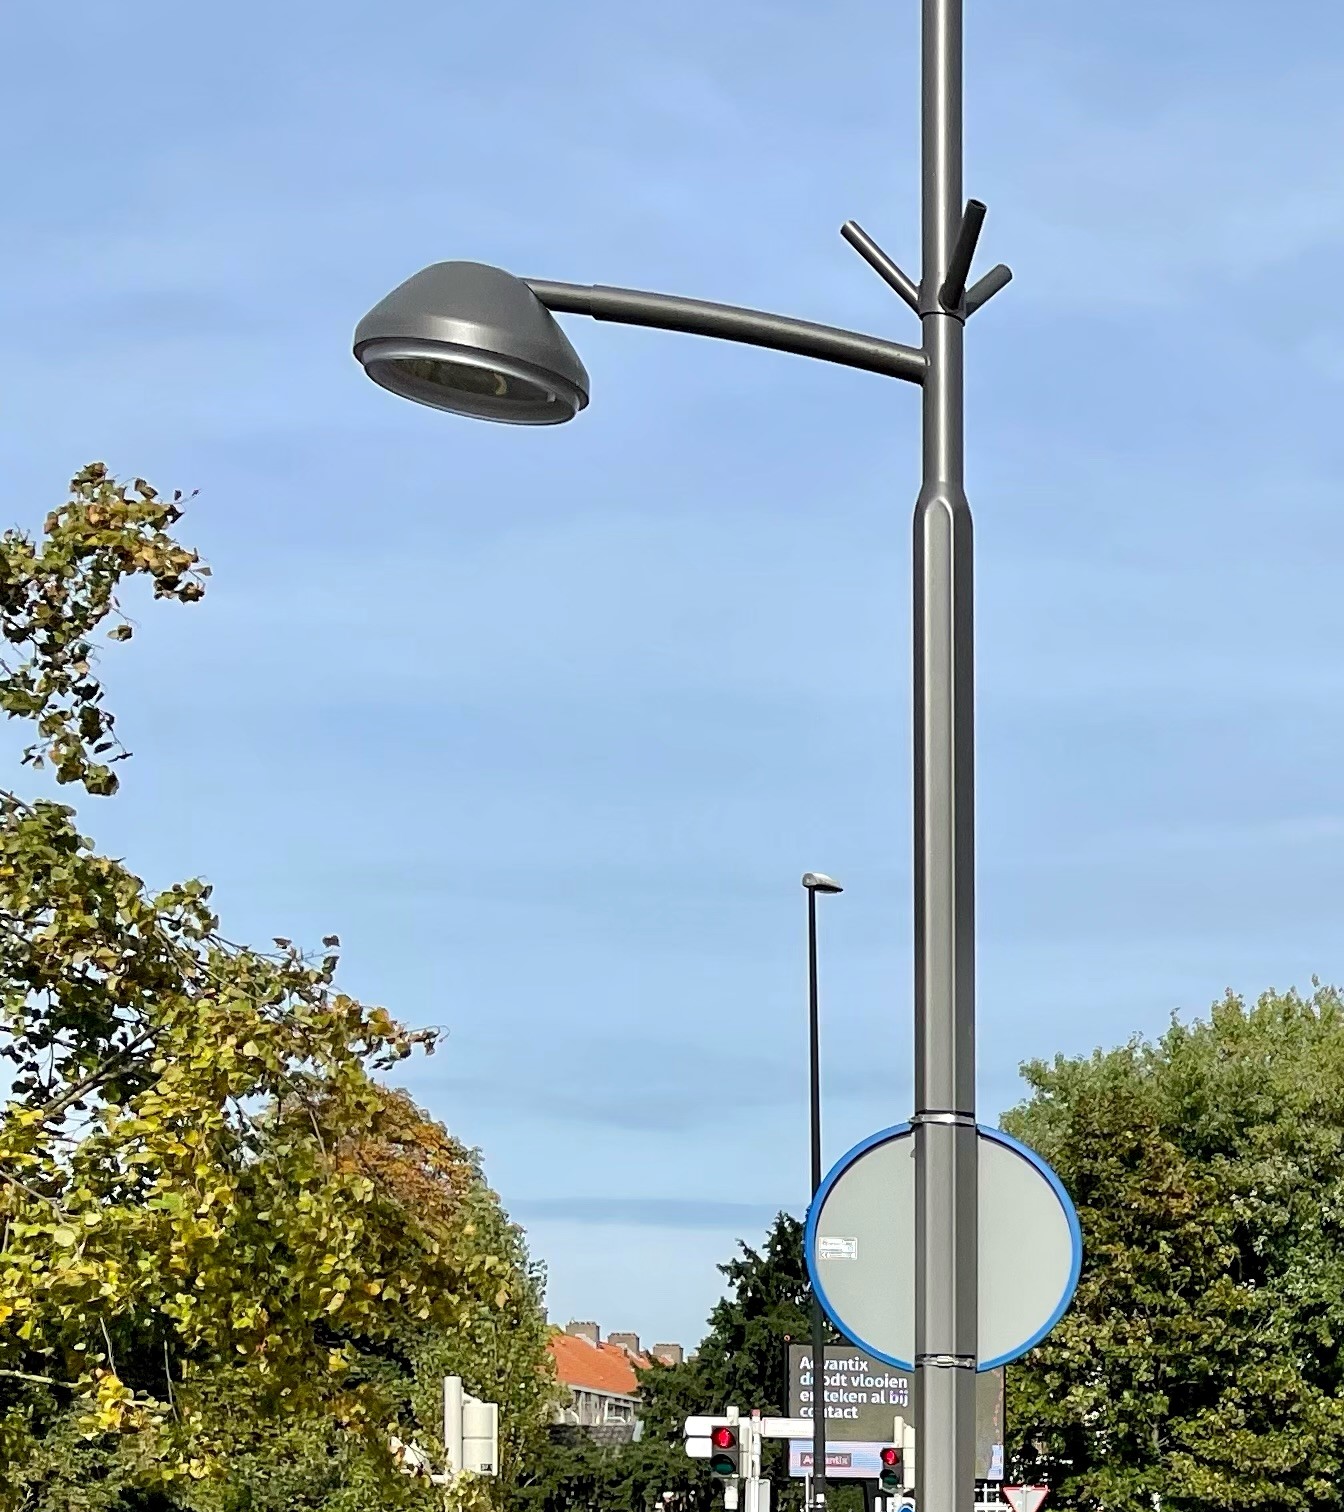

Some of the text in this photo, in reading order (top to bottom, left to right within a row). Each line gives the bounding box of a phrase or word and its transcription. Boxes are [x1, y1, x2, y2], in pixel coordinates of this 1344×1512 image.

[800, 1372, 908, 1388] dodt vlooien
[823, 1389, 867, 1404] teken
[870, 1390, 886, 1404] al
[889, 1389, 909, 1407] bij
[803, 1454, 849, 1466] Aantix
